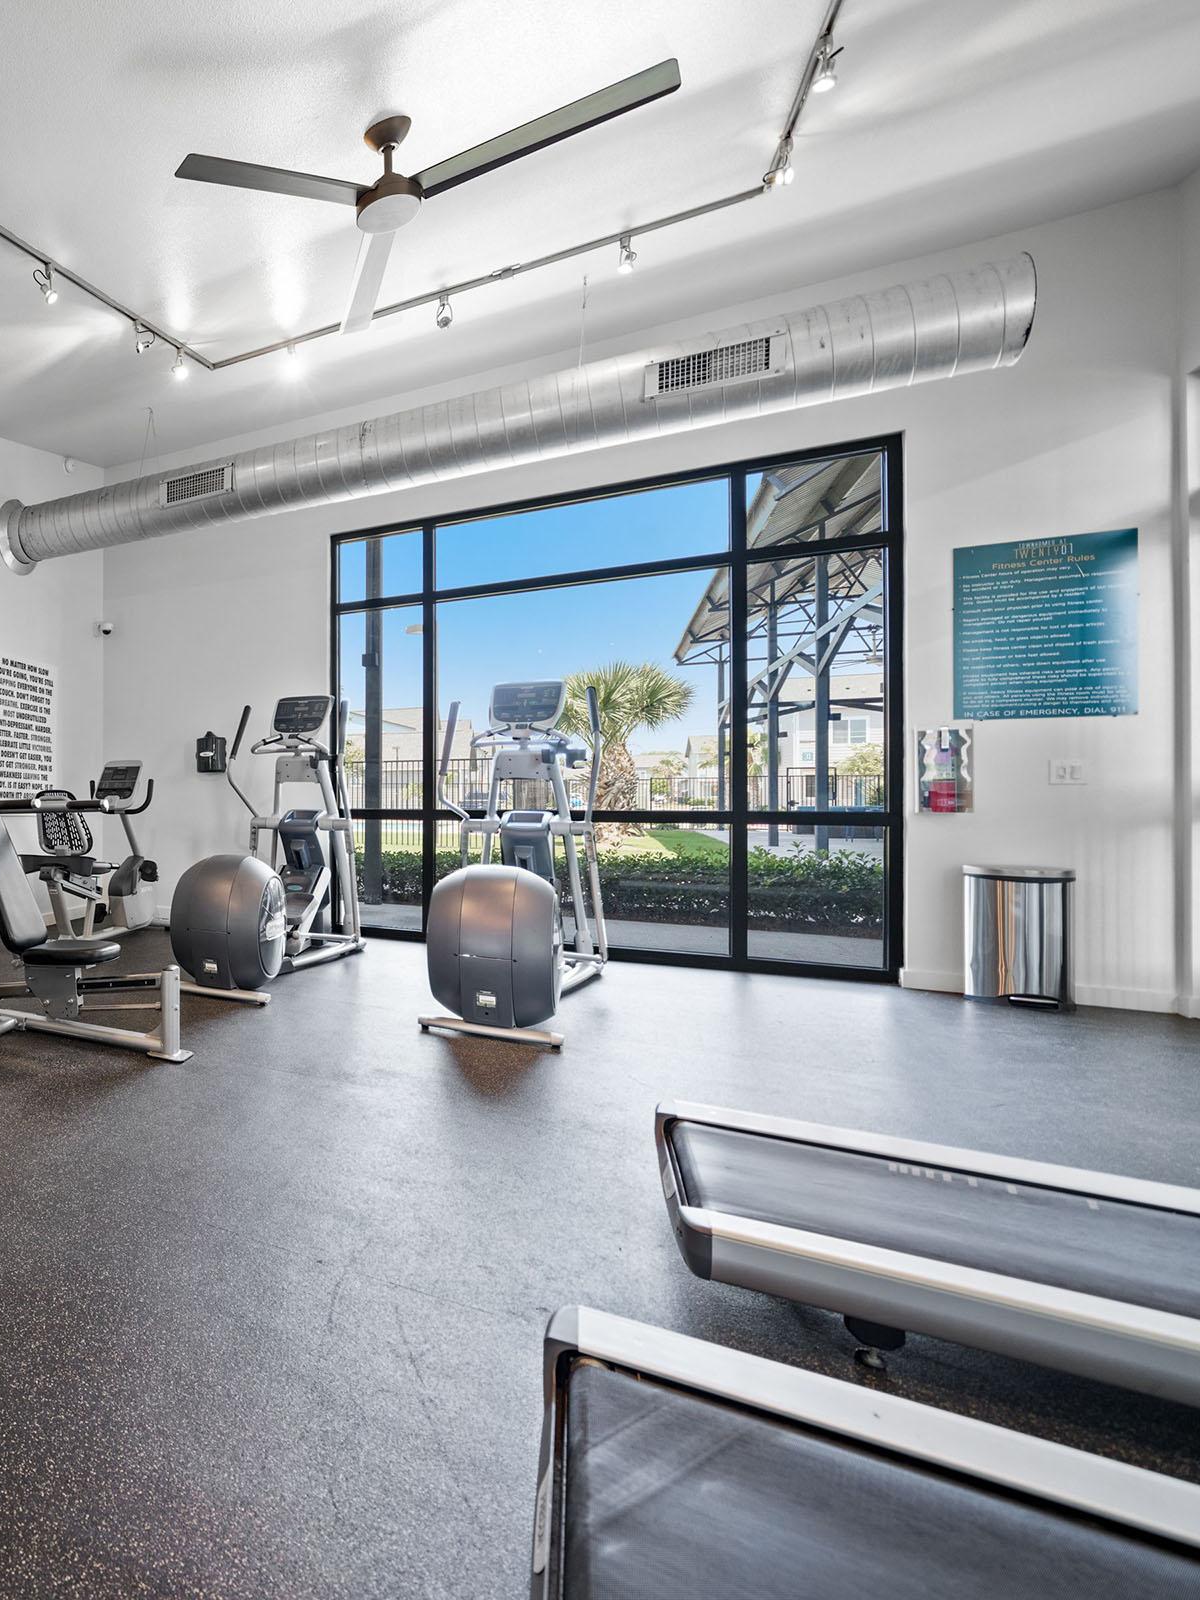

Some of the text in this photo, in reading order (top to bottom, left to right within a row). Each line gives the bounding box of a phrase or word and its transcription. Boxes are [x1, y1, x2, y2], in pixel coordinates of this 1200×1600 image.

[1014, 542, 1073, 560] TWENTY01
[992, 553, 1095, 570] Fitness Center Rules
[2, 658, 48, 676] NO MATTER HOW SLOW
[13, 671, 28, 681] GOING,
[30, 675, 43, 685] YOU'RE
[45, 678, 53, 687] STILL
[18, 682, 37, 693] EVERYONE
[0, 688, 15, 698] COUCH.
[16, 692, 28, 701] DON'T
[30, 694, 44, 704] FORGET
[20, 702, 38, 712] EXERCISE
[3, 709, 46, 724] MOST UNDERUTILIZED
[35, 725, 52, 735] HARDER.
[14, 732, 29, 741] FASTER.
[31, 734, 52, 744] STRONGER.
[19, 742, 31, 751] LITTLE
[32, 744, 52, 754] VICTORIES.
[1, 750, 18, 759] DOESN'T
[28, 754, 42, 762] EASIER,
[15, 762, 37, 771] STRONGER.
[38, 765, 47, 773] PAIN
[0, 770, 22, 780] WEAKNESS
[23, 773, 40, 782] LEAVING
[8, 781, 11, 789] IS
[13, 782, 16, 790] IT
[18, 782, 31, 791] EASY?
